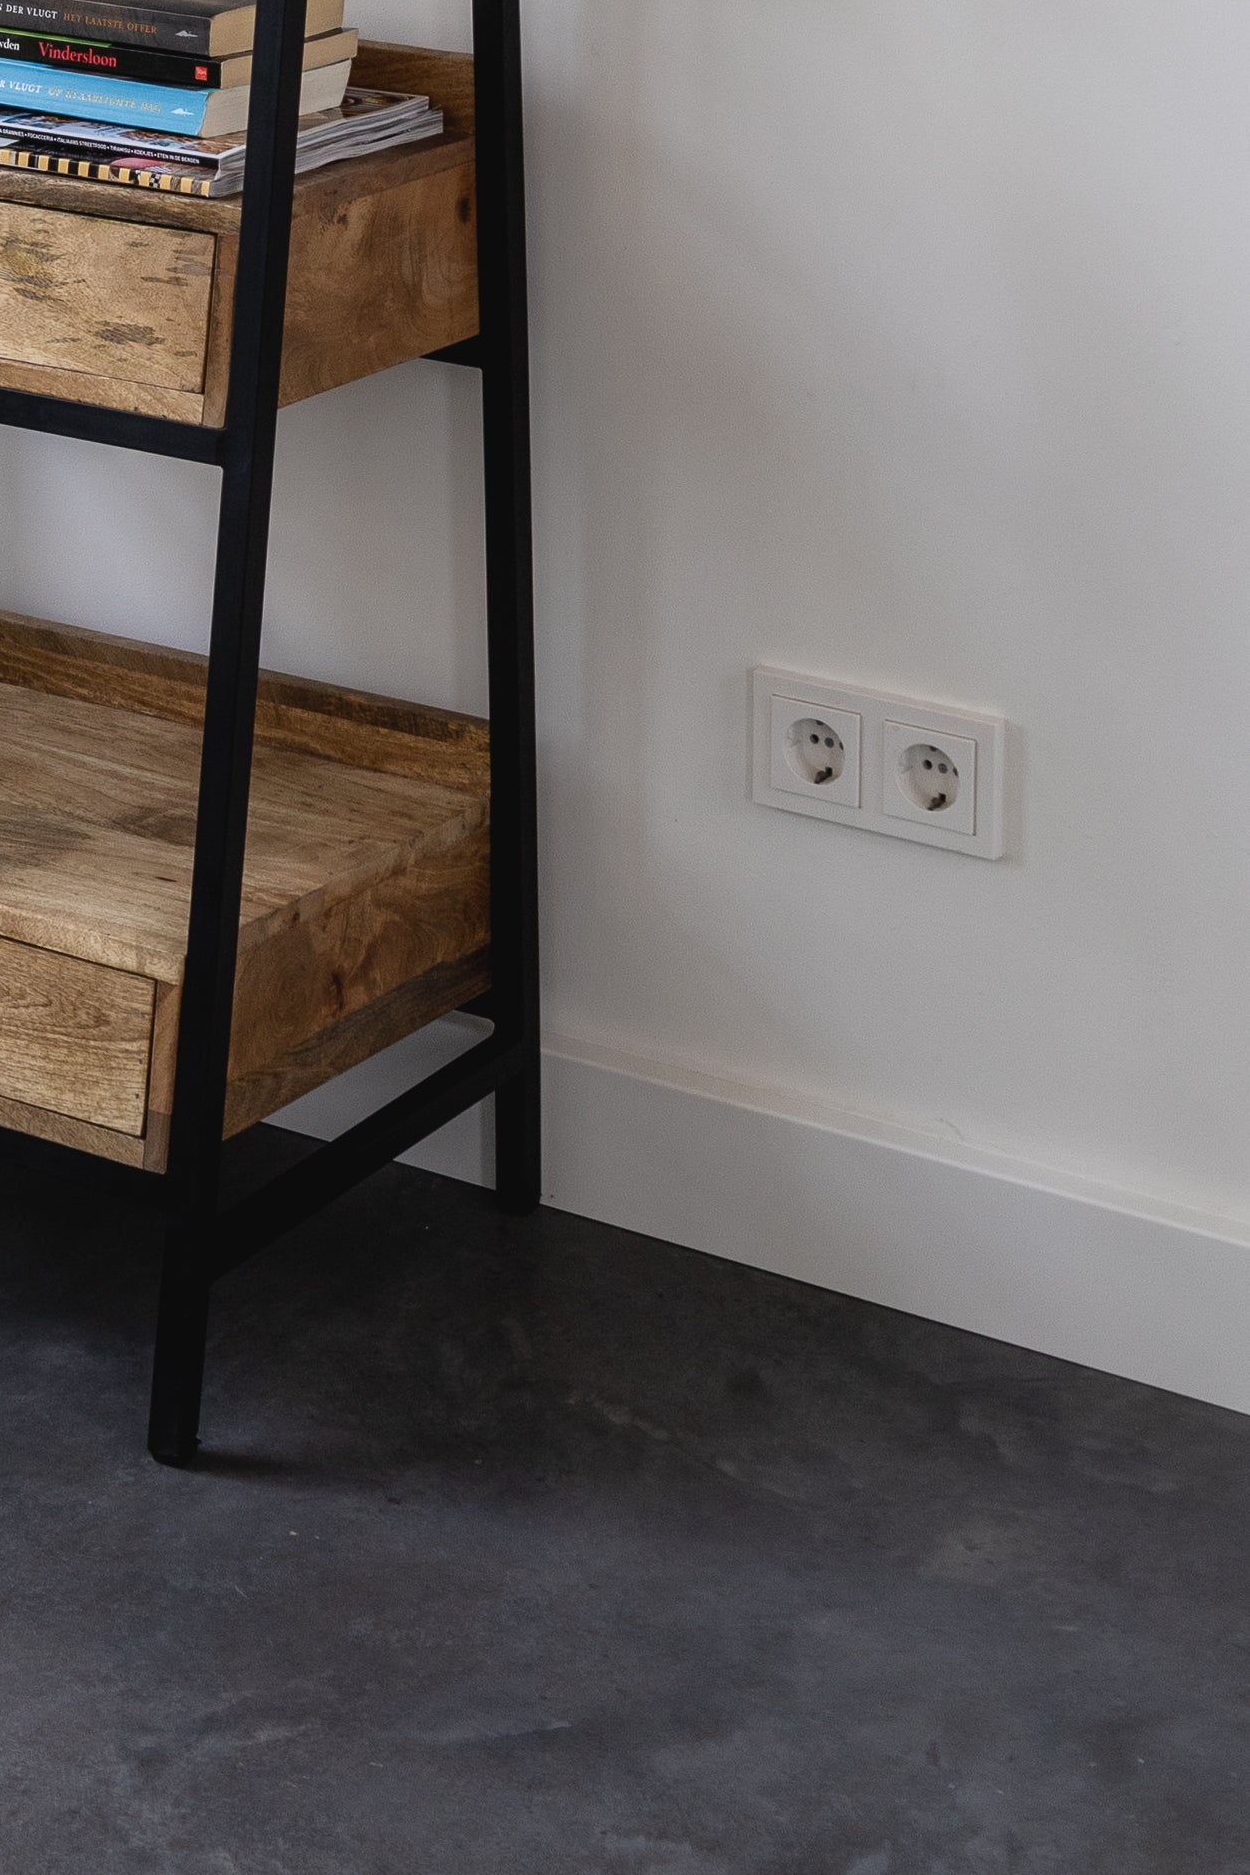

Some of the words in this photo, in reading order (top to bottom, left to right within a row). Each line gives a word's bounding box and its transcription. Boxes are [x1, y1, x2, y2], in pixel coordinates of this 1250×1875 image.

[6, 4, 24, 14] DER
[27, 7, 58, 19] VLUGT
[63, 12, 81, 23] HET
[85, 16, 123, 29] LAATSTE
[127, 22, 157, 34] OFFER
[38, 41, 117, 68] Vindersloon
[9, 81, 42, 94] VLUGT
